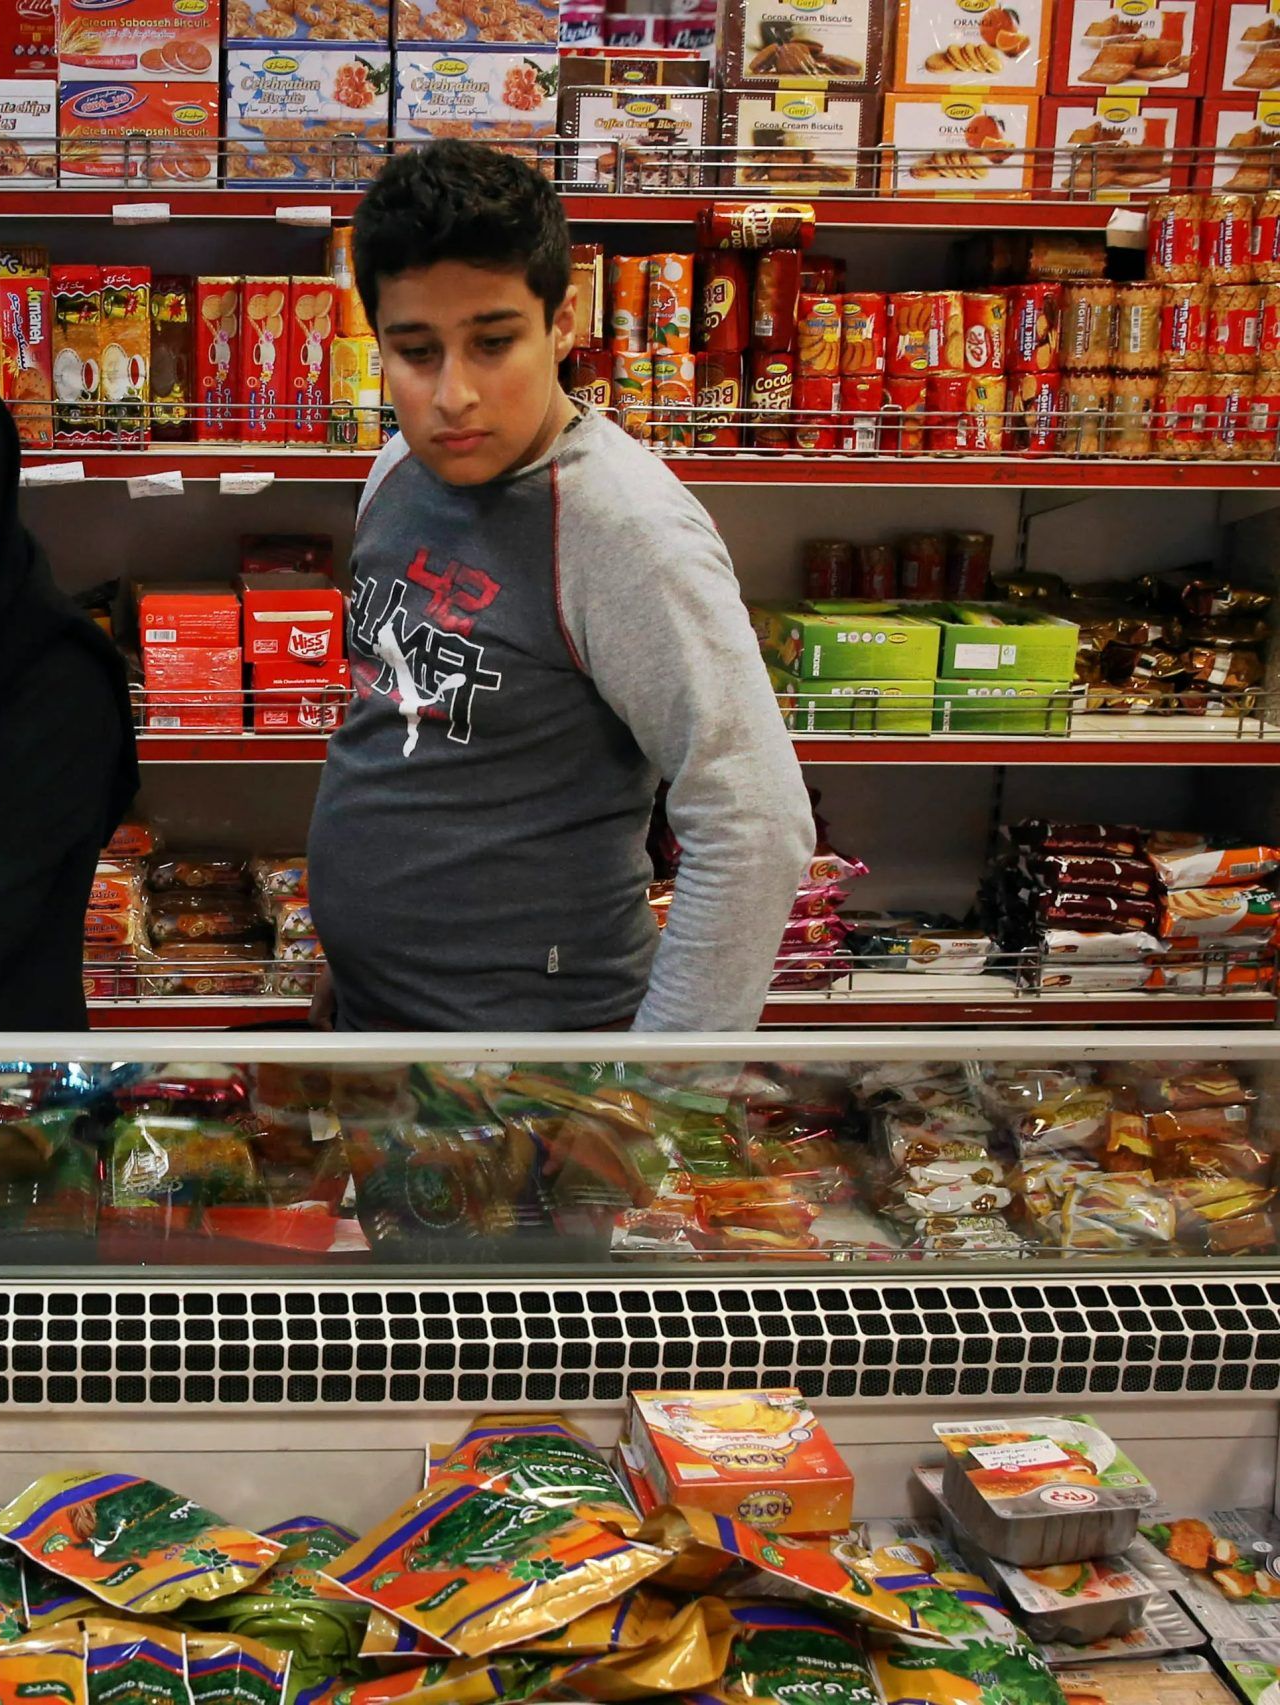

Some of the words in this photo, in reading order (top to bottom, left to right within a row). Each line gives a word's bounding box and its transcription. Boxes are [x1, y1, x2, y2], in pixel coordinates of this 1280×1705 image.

[81, 17, 117, 28] Cream
[120, 17, 171, 28] Sabooseh
[173, 17, 211, 28] Biscuits
[761, 13, 786, 23] Cocoa
[788, 13, 818, 23] Cream
[820, 13, 853, 24] Biscuits
[952, 18, 993, 28] ORANGE
[240, 76, 320, 92] Celebration
[410, 76, 490, 92] Celebration
[17, 101, 51, 117] chips
[628, 102, 654, 114] Gorji
[787, 105, 812, 117] Gorji
[948, 107, 972, 117] Gorji
[81, 126, 118, 137] Cream
[173, 126, 210, 137] Biscuits
[594, 118, 624, 131] Coffee
[655, 118, 693, 129] Biscuits
[753, 121, 778, 131] Cocoa
[780, 121, 810, 131] Cream
[811, 121, 844, 131] Biscuits
[938, 125, 980, 135] ORANGE
[1224, 243, 1233, 273] SAGHE
[26, 285, 44, 345] Jomaneh
[1024, 299, 1035, 328] TALAIE
[13, 313, 30, 371] بیسکویت
[991, 322, 1002, 369] Digestive
[1023, 331, 1033, 362] SAGHE
[755, 373, 793, 391] Cocoa
[406, 546, 502, 637] 42
[291, 633, 324, 651] Hiss
[776, 1680, 845, 1700] سبزی
